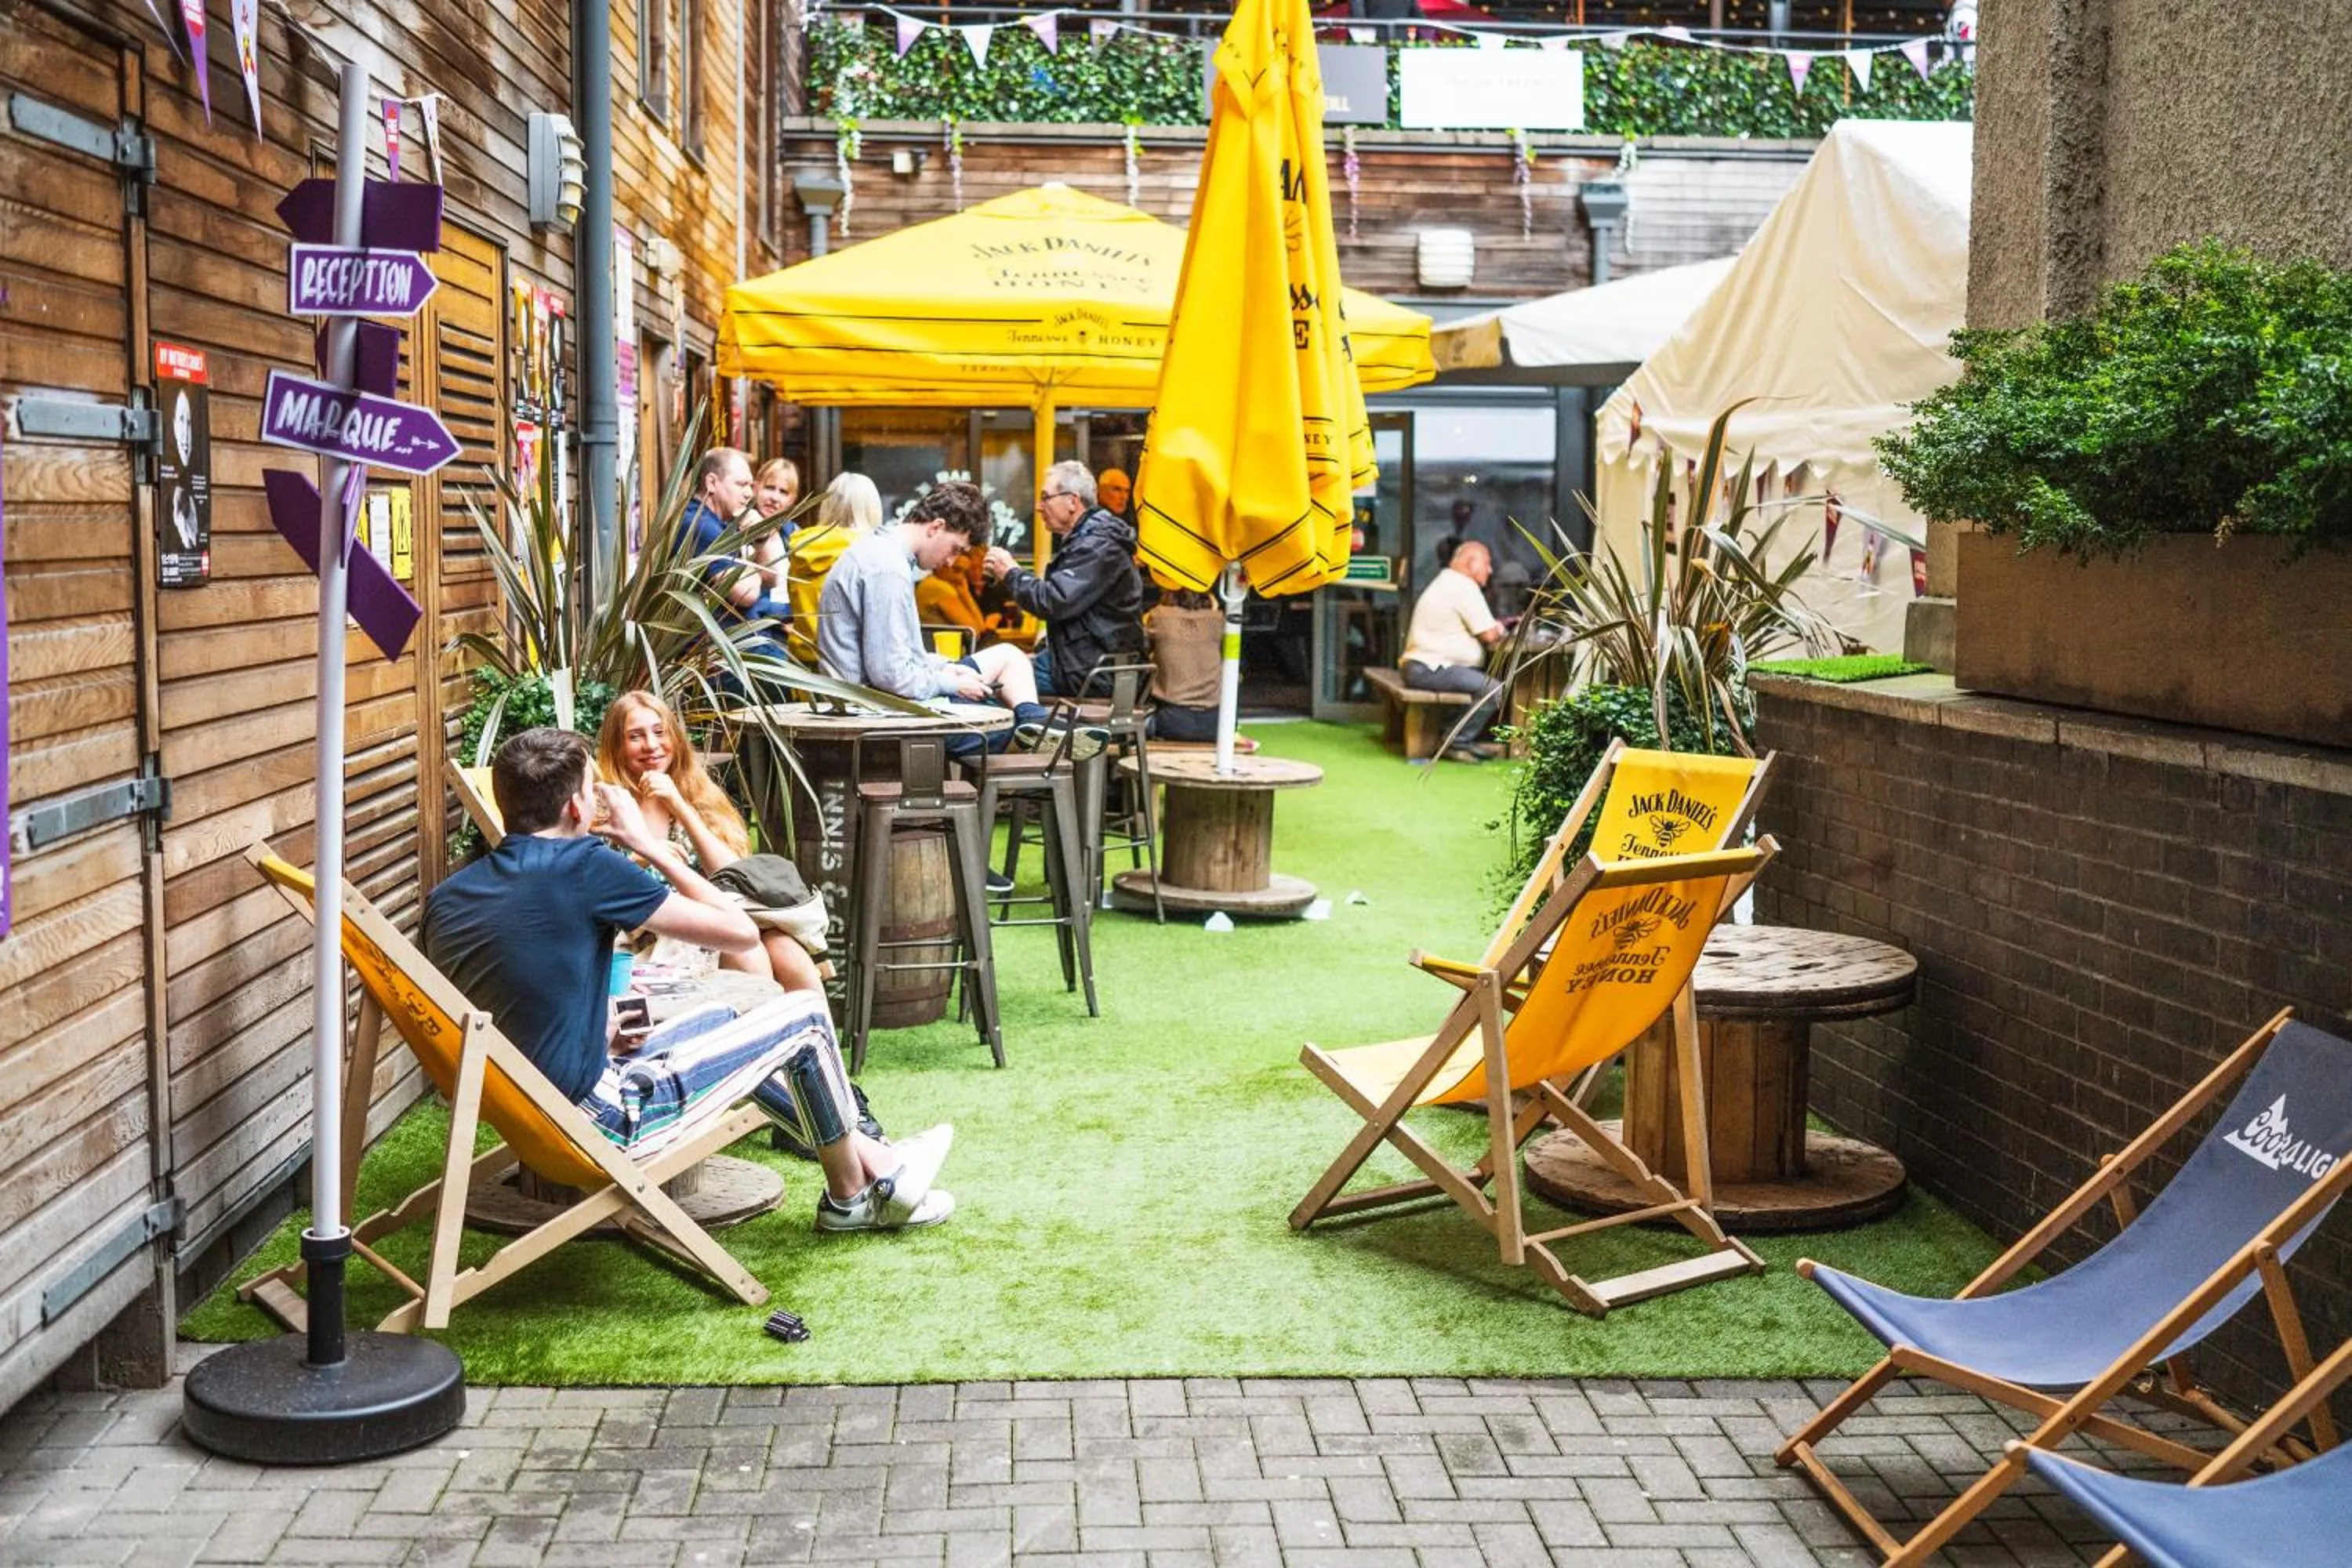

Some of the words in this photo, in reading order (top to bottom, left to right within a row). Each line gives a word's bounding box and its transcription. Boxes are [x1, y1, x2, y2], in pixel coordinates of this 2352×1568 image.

[300, 257, 413, 307] RECEPTION
[1098, 334, 1158, 347] HONEY
[821, 780, 845, 871] INNIS
[1628, 791, 1665, 818] JACK
[1666, 789, 1718, 832] DANIEL'S
[2292, 1145, 2340, 1179] LIG
